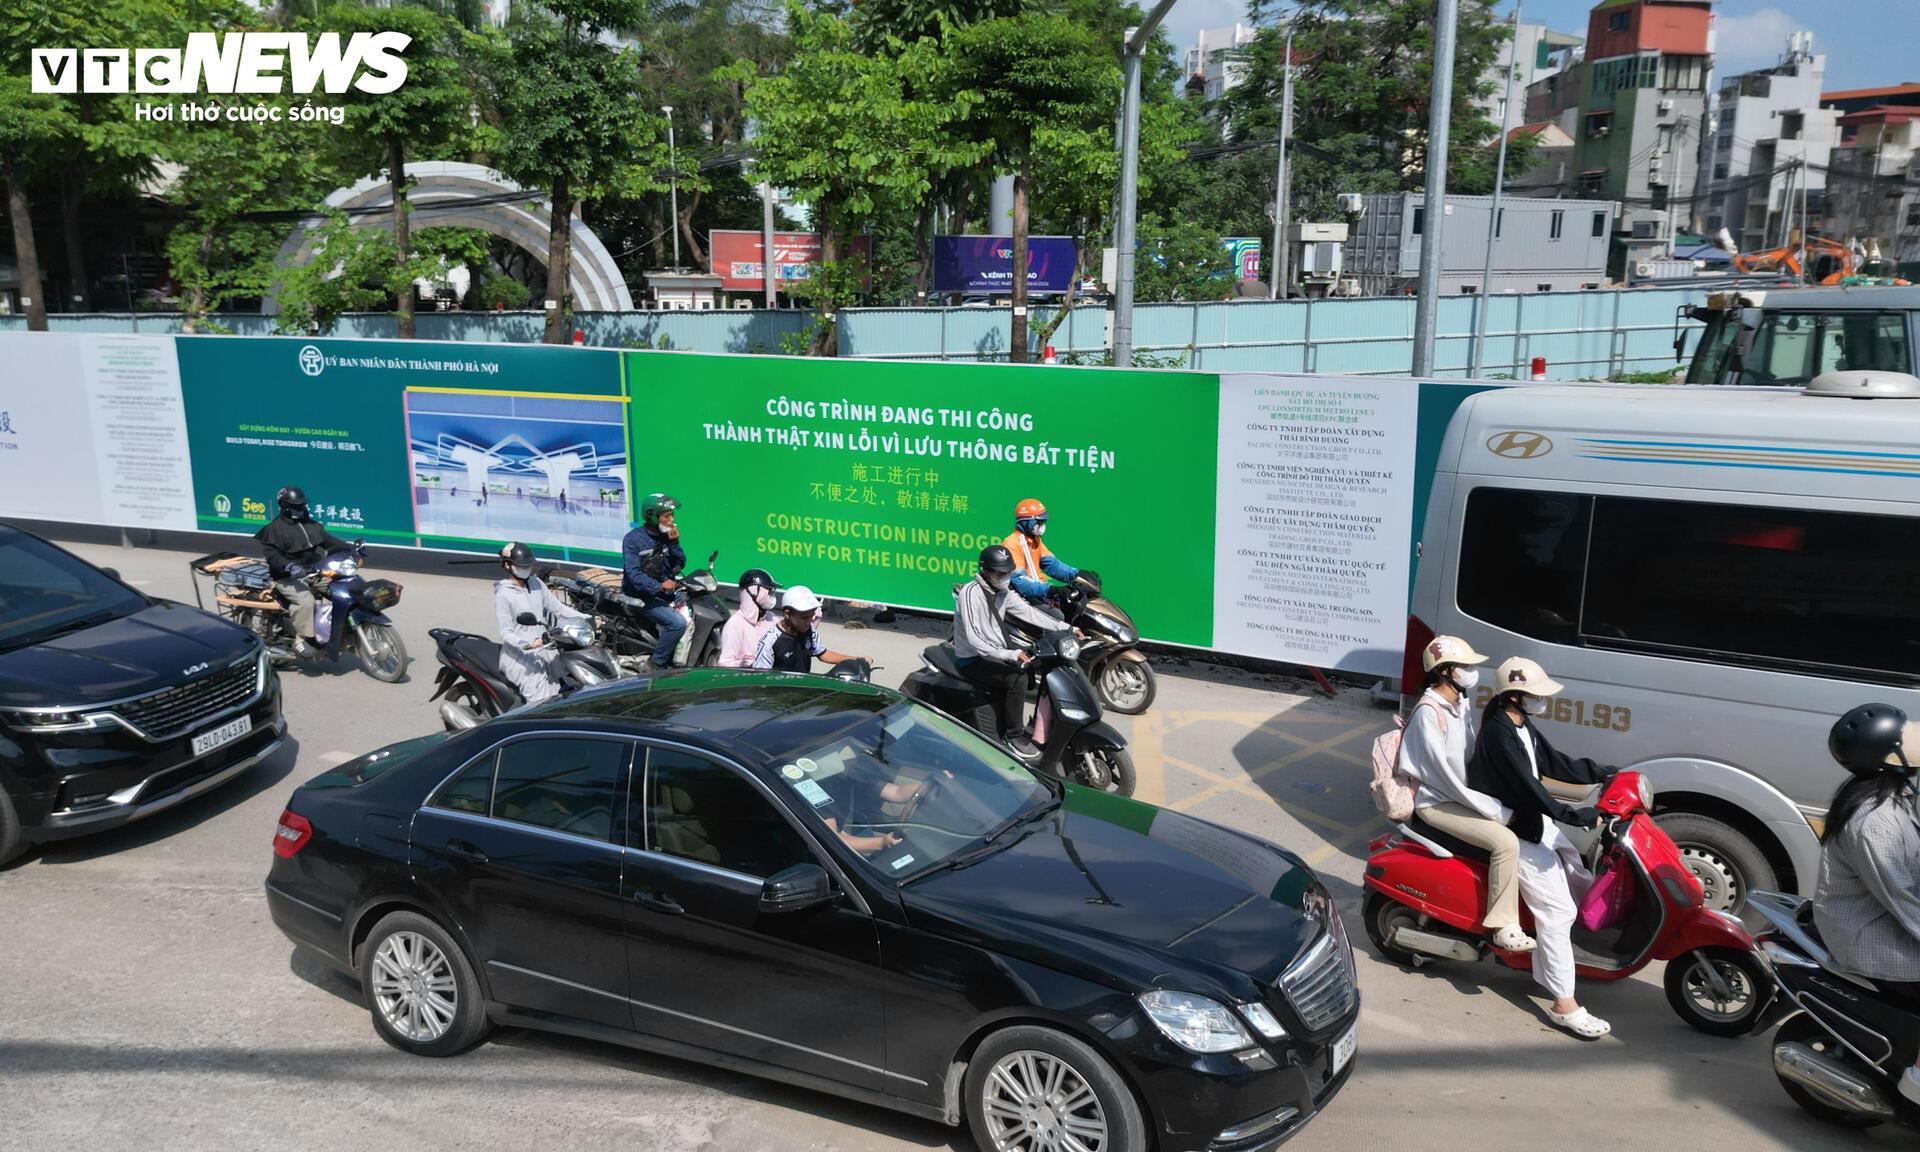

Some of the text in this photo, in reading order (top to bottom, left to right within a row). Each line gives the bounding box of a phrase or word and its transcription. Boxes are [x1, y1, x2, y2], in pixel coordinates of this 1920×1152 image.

[340, 358, 358, 367] BAN
[360, 356, 386, 368] NHÂN
[389, 357, 407, 369] DÂN
[408, 358, 440, 370] THÀNH
[444, 360, 463, 371] PHỐ
[466, 360, 480, 372] HÀ
[481, 362, 498, 374] NỘI
[766, 396, 1034, 431] CÔNG TRÌNH ĐANG THI CÔNG
[703, 420, 1115, 474] THÀNH THẬT XIN LỖI VÌ LƯU THÔNG BẤT TIỆN
[852, 462, 940, 488] 施工进行中
[766, 512, 1002, 551] CONSTRUCTION IN PROGR
[756, 537, 982, 578] SORRY FOR THE INCONVE
